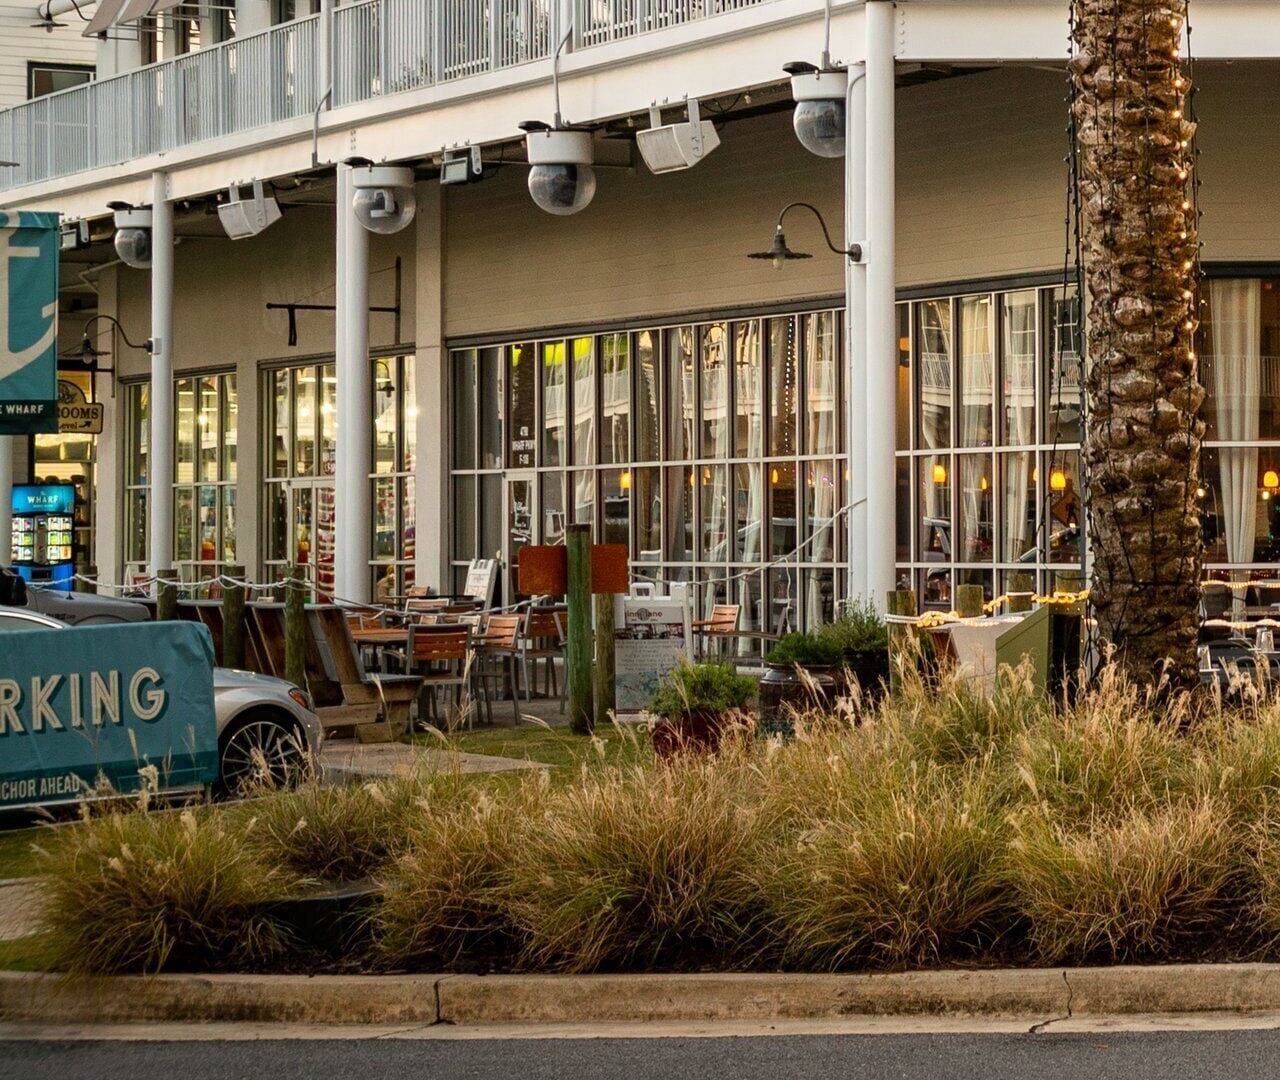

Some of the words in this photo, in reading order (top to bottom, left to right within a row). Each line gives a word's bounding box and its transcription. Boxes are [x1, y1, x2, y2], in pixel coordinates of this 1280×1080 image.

[6, 404, 44, 415] WHARF
[27, 495, 59, 505] WHARF
[39, 775, 81, 796] AHEAD
